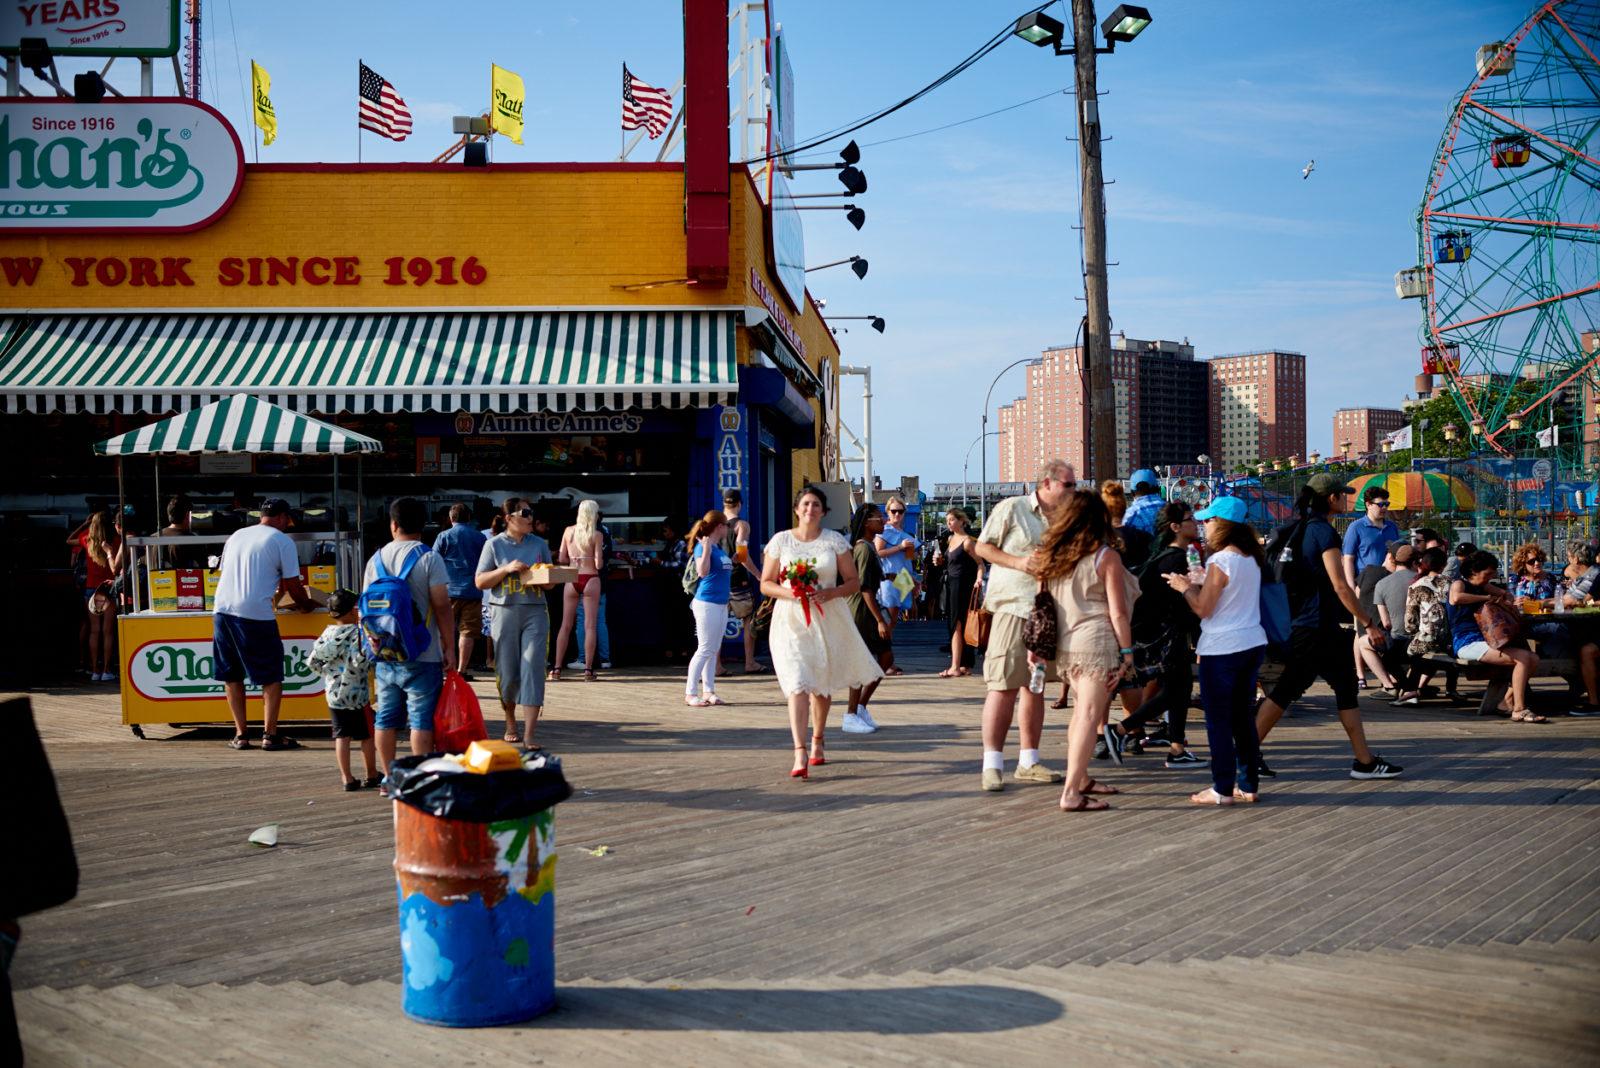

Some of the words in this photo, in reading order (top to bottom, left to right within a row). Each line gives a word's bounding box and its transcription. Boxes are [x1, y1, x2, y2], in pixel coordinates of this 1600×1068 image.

[18, 0, 120, 26] YEARS
[70, 36, 91, 45] Since
[92, 29, 110, 41] 1916
[32, 117, 76, 131] Since
[80, 117, 115, 131] 1916
[0, 256, 43, 287] W
[63, 256, 195, 287] YORK
[217, 256, 361, 287] SINCE
[384, 256, 488, 286] 1916
